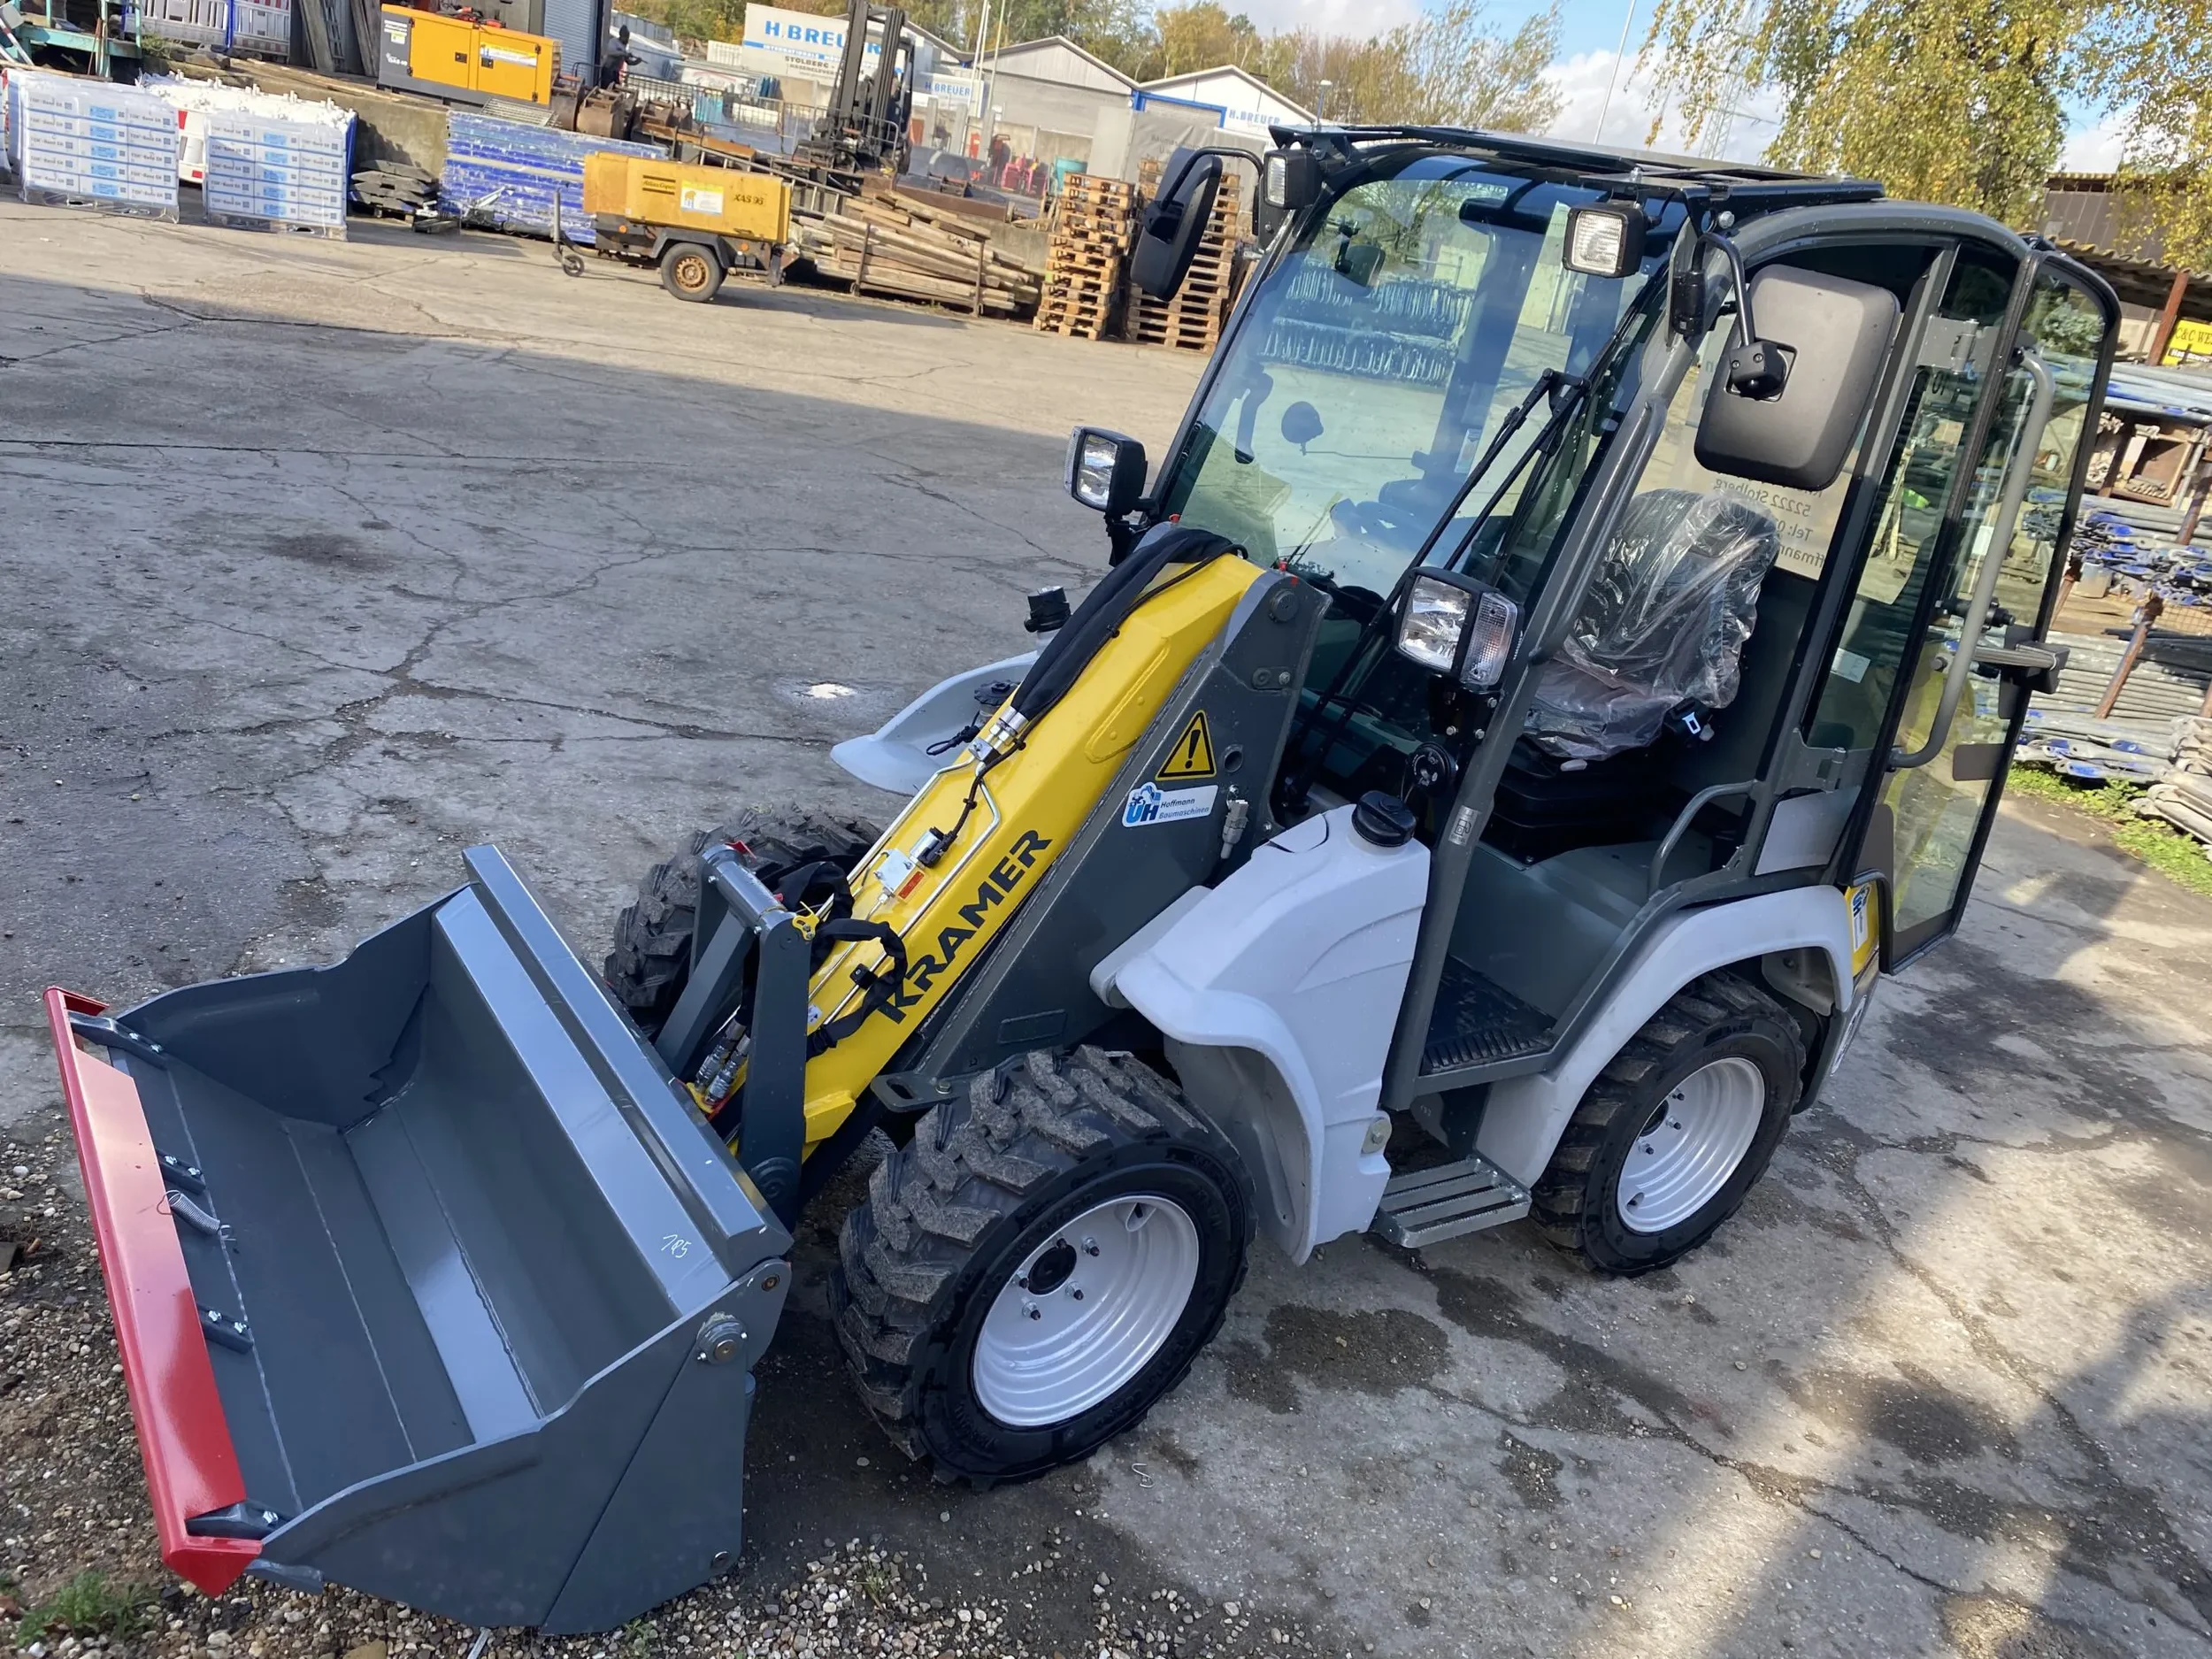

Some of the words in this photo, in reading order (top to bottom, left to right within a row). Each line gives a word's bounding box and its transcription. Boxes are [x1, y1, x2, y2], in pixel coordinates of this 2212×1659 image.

[785, 55, 830, 69] STOLBERG
[2176, 327, 2196, 342] C&C
[1160, 797, 1195, 809] Hoffmann
[1158, 806, 1210, 819] Baumaschinen
[877, 829, 1053, 1025] KRAMER
